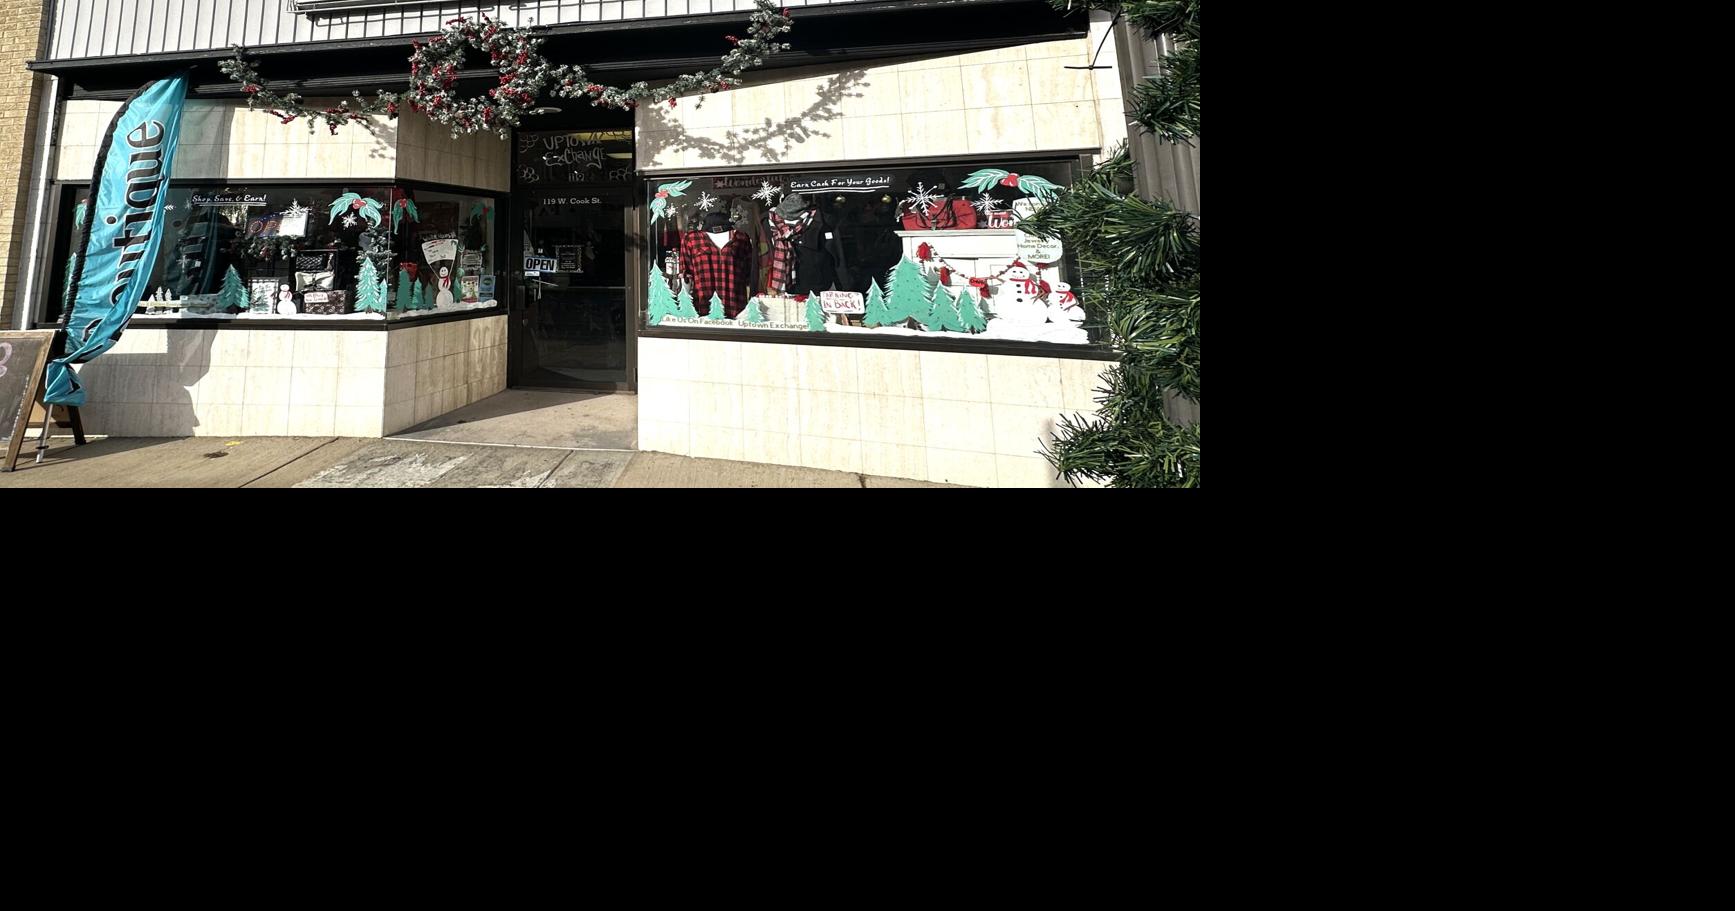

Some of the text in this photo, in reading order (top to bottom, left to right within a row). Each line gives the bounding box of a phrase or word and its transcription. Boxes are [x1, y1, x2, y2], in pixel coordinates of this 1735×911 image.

[790, 176, 890, 189] Earn Cash For Your Goods!
[243, 193, 267, 202] Earn!
[543, 196, 603, 205] 119 W. Cook St.
[526, 257, 555, 271] OPEN
[677, 316, 687, 324] Us
[687, 316, 699, 325] On
[699, 317, 734, 326] Facebook
[737, 319, 769, 329] Uptown
[769, 321, 810, 331] Exchange!
